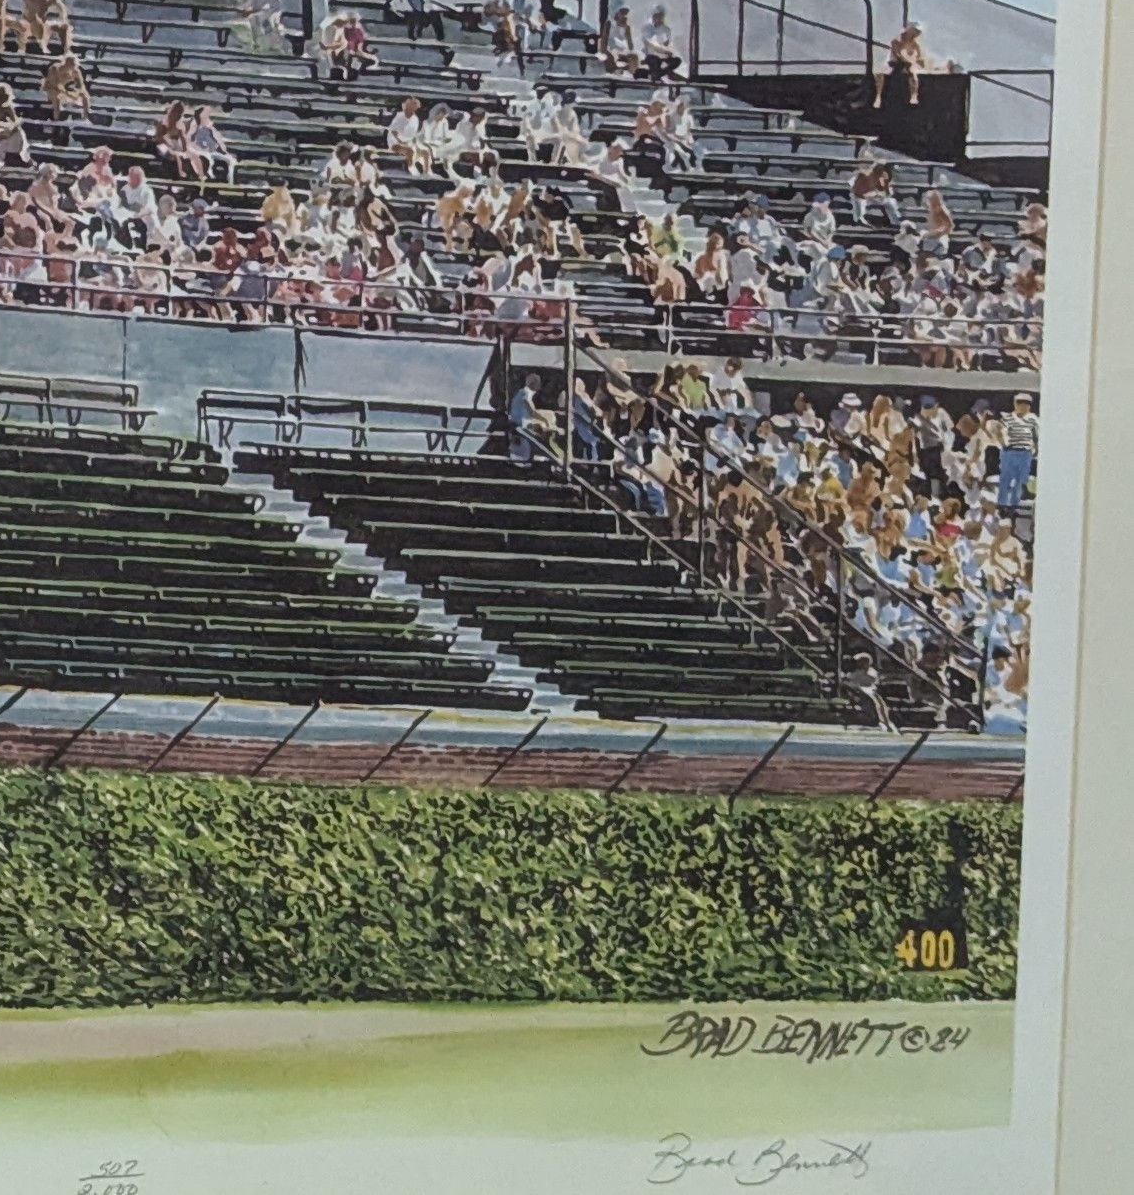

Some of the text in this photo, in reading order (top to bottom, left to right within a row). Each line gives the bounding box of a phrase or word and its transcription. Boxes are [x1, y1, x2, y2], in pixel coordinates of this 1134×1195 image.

[894, 929, 956, 969] 400
[640, 1010, 758, 1059] BRAD
[751, 1014, 907, 1064] BENNETT
